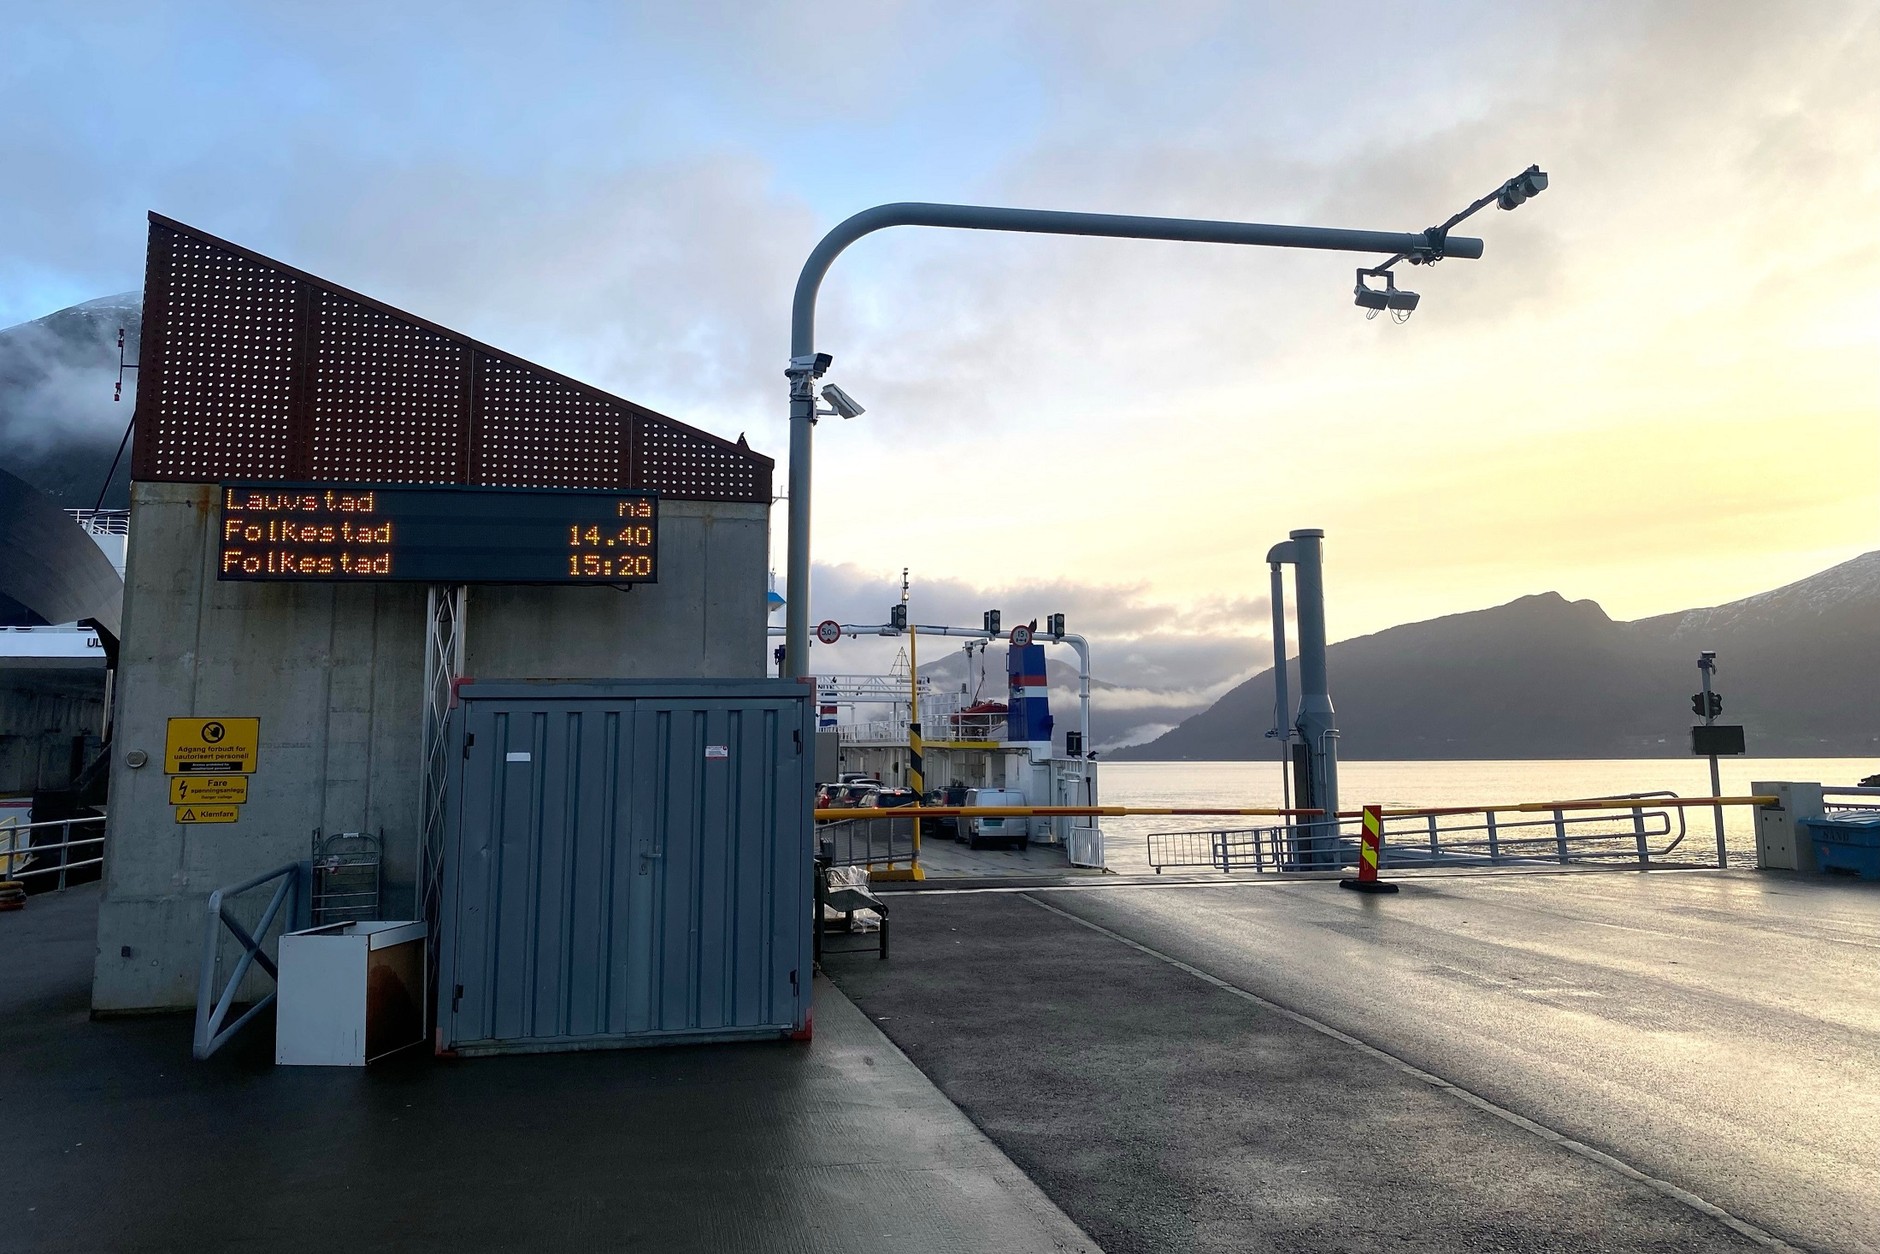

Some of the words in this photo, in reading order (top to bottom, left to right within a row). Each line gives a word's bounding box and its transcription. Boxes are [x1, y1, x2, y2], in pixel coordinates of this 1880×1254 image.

[226, 488, 374, 512] Lauvstad
[225, 519, 391, 543] Folkestad
[570, 525, 651, 546] 14.40
[223, 550, 390, 574] Folkestad
[570, 555, 651, 575] 15:20
[178, 746, 206, 754] Adgang
[215, 753, 249, 761] personell
[1823, 830, 1850, 842] SAND
